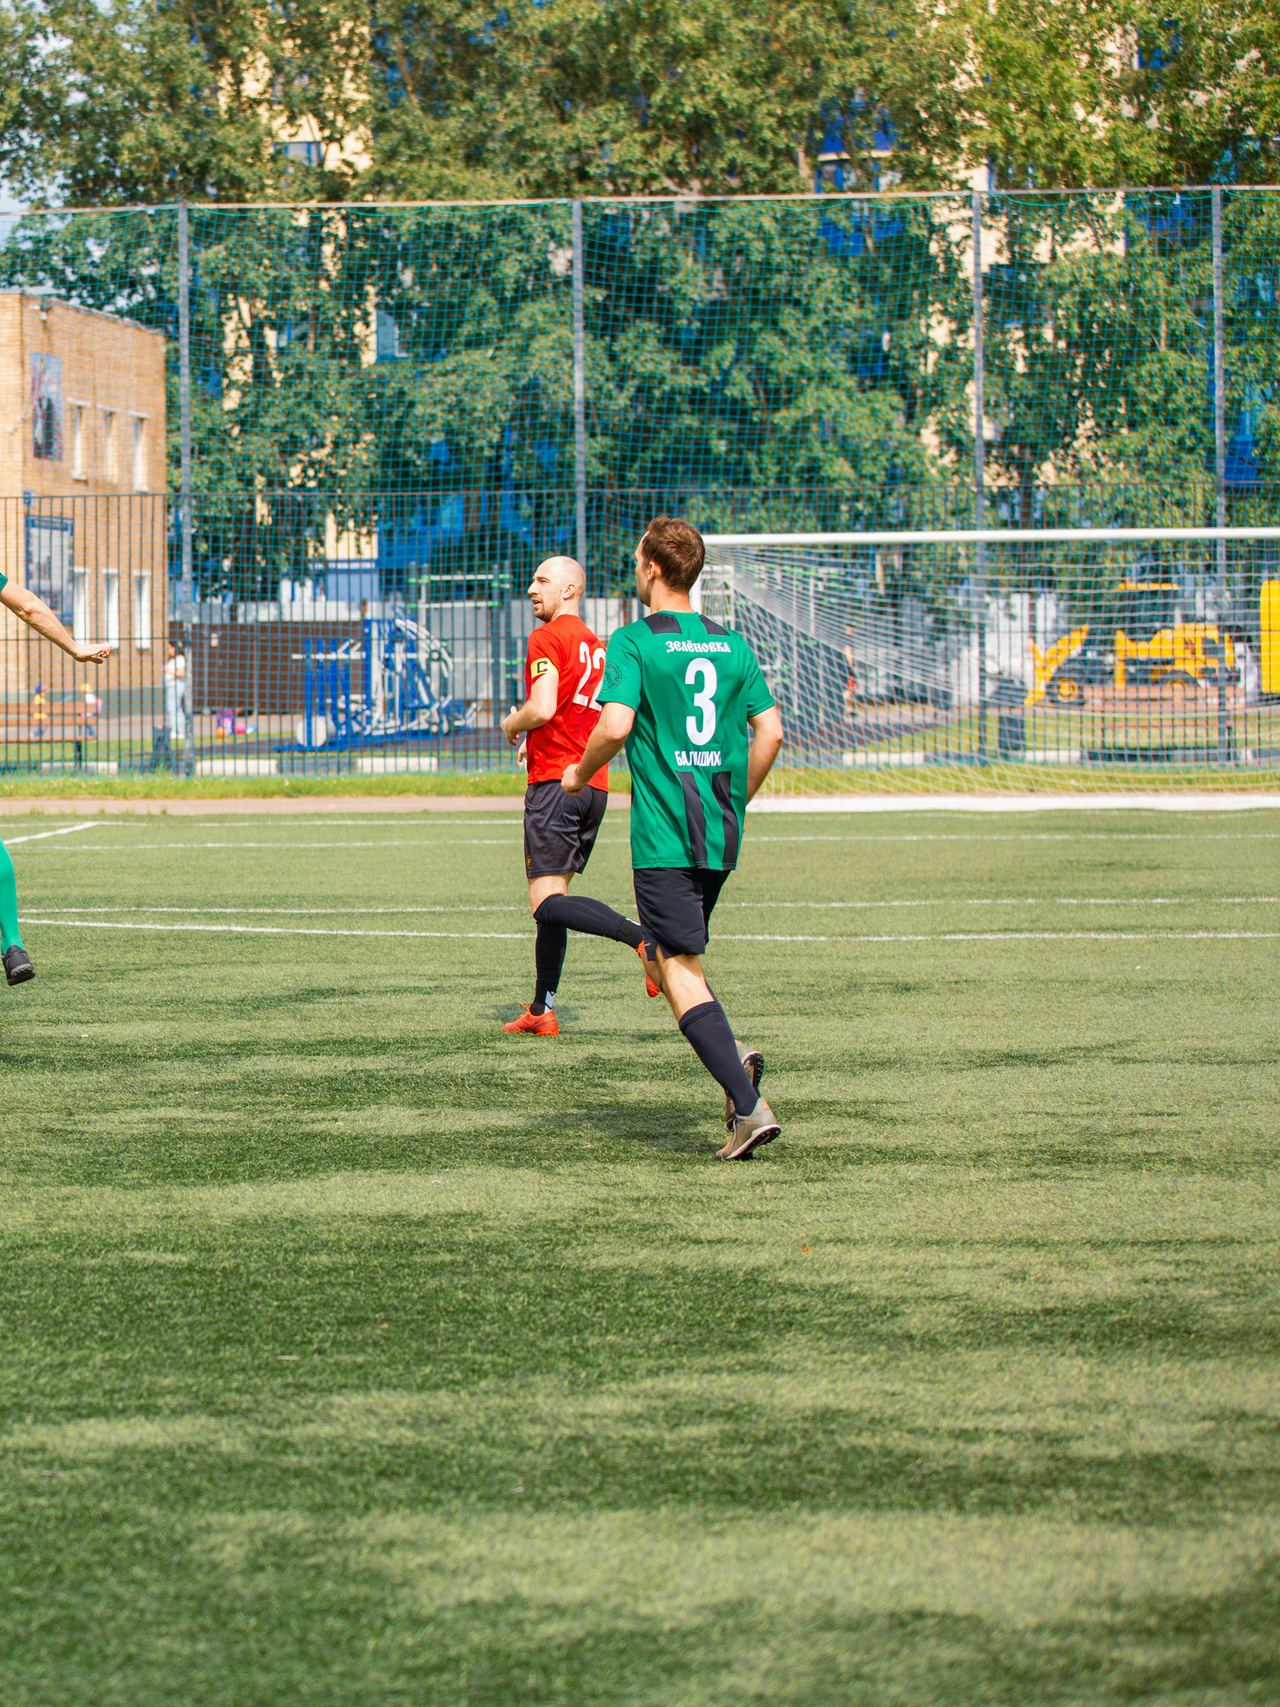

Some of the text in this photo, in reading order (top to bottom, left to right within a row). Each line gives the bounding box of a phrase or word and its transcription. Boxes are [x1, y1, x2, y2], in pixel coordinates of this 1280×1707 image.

[537, 661, 548, 673] C
[572, 641, 606, 711] 22
[685, 657, 718, 746] 3
